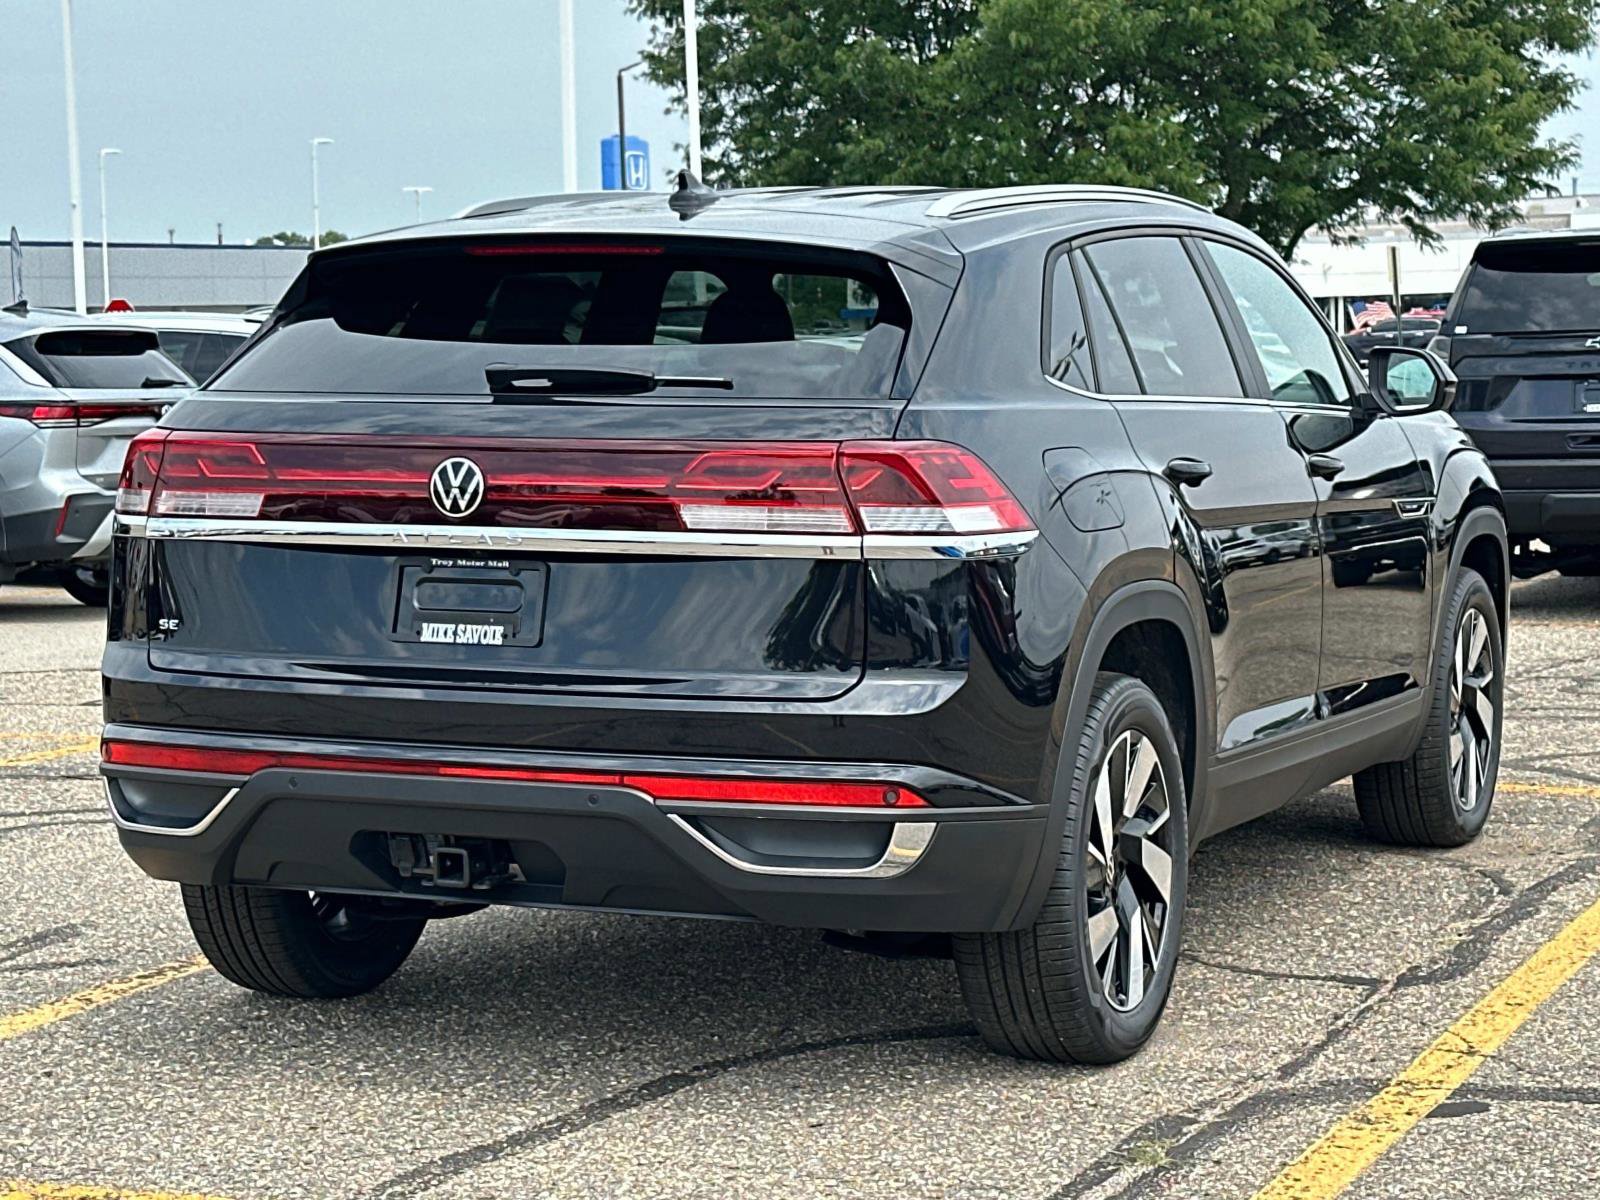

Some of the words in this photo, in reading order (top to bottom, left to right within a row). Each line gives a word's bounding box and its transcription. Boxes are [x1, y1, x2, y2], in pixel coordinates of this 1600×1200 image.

[392, 530, 523, 546] ATLAS
[430, 558, 454, 567] Troy
[158, 618, 179, 630] SE
[420, 622, 456, 643] MIKE
[456, 624, 504, 645] SAVOIE
